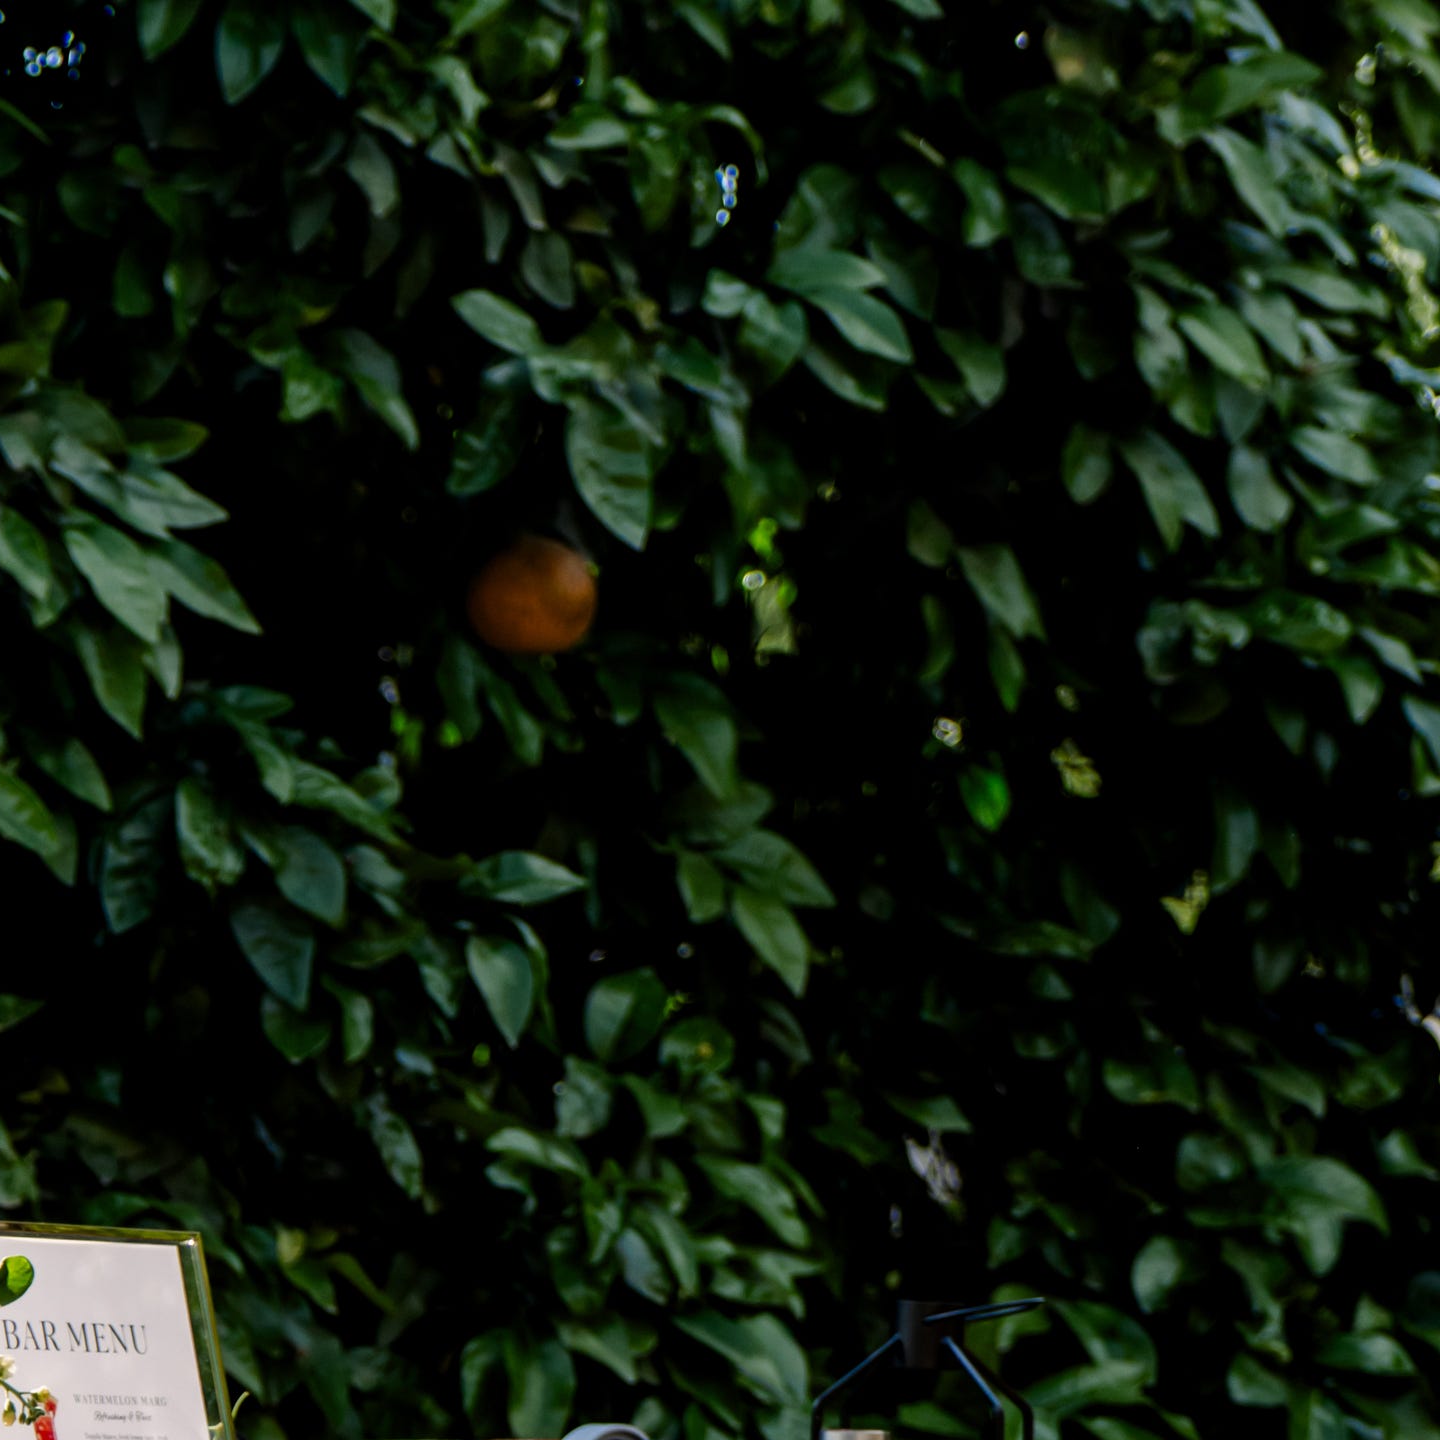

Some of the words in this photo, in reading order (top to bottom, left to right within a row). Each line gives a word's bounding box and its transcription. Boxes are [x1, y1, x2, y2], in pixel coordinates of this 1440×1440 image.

[2, 1319, 60, 1351] BAR
[66, 1321, 148, 1355] MENU
[73, 1394, 138, 1405] WATERMELON
[140, 1395, 168, 1407] MARG
